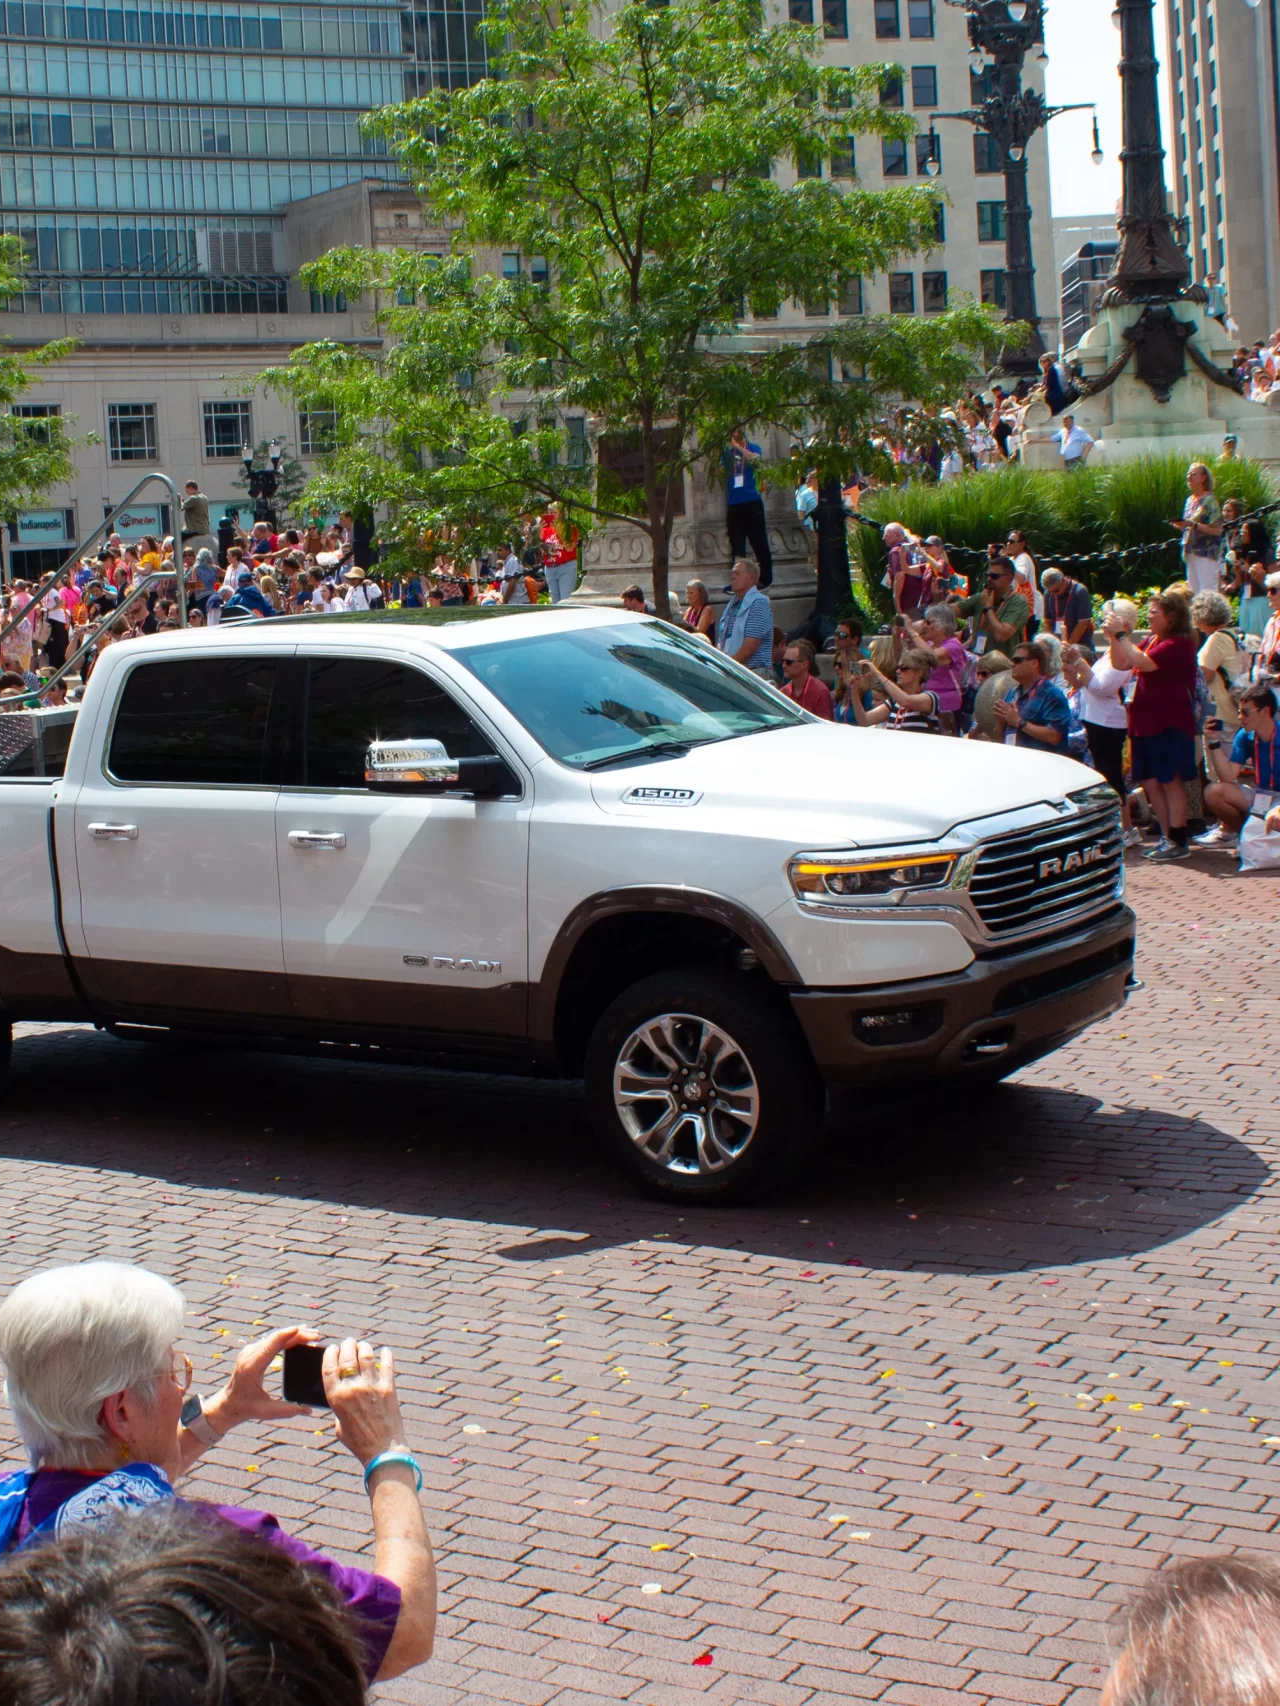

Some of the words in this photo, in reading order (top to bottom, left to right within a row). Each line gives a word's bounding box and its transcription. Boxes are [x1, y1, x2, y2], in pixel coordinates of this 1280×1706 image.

[21, 518, 62, 531] Indianapolis
[131, 517, 144, 525] the
[144, 516, 156, 525] fan
[637, 788, 692, 799] 1500
[1039, 844, 1101, 878] RAM
